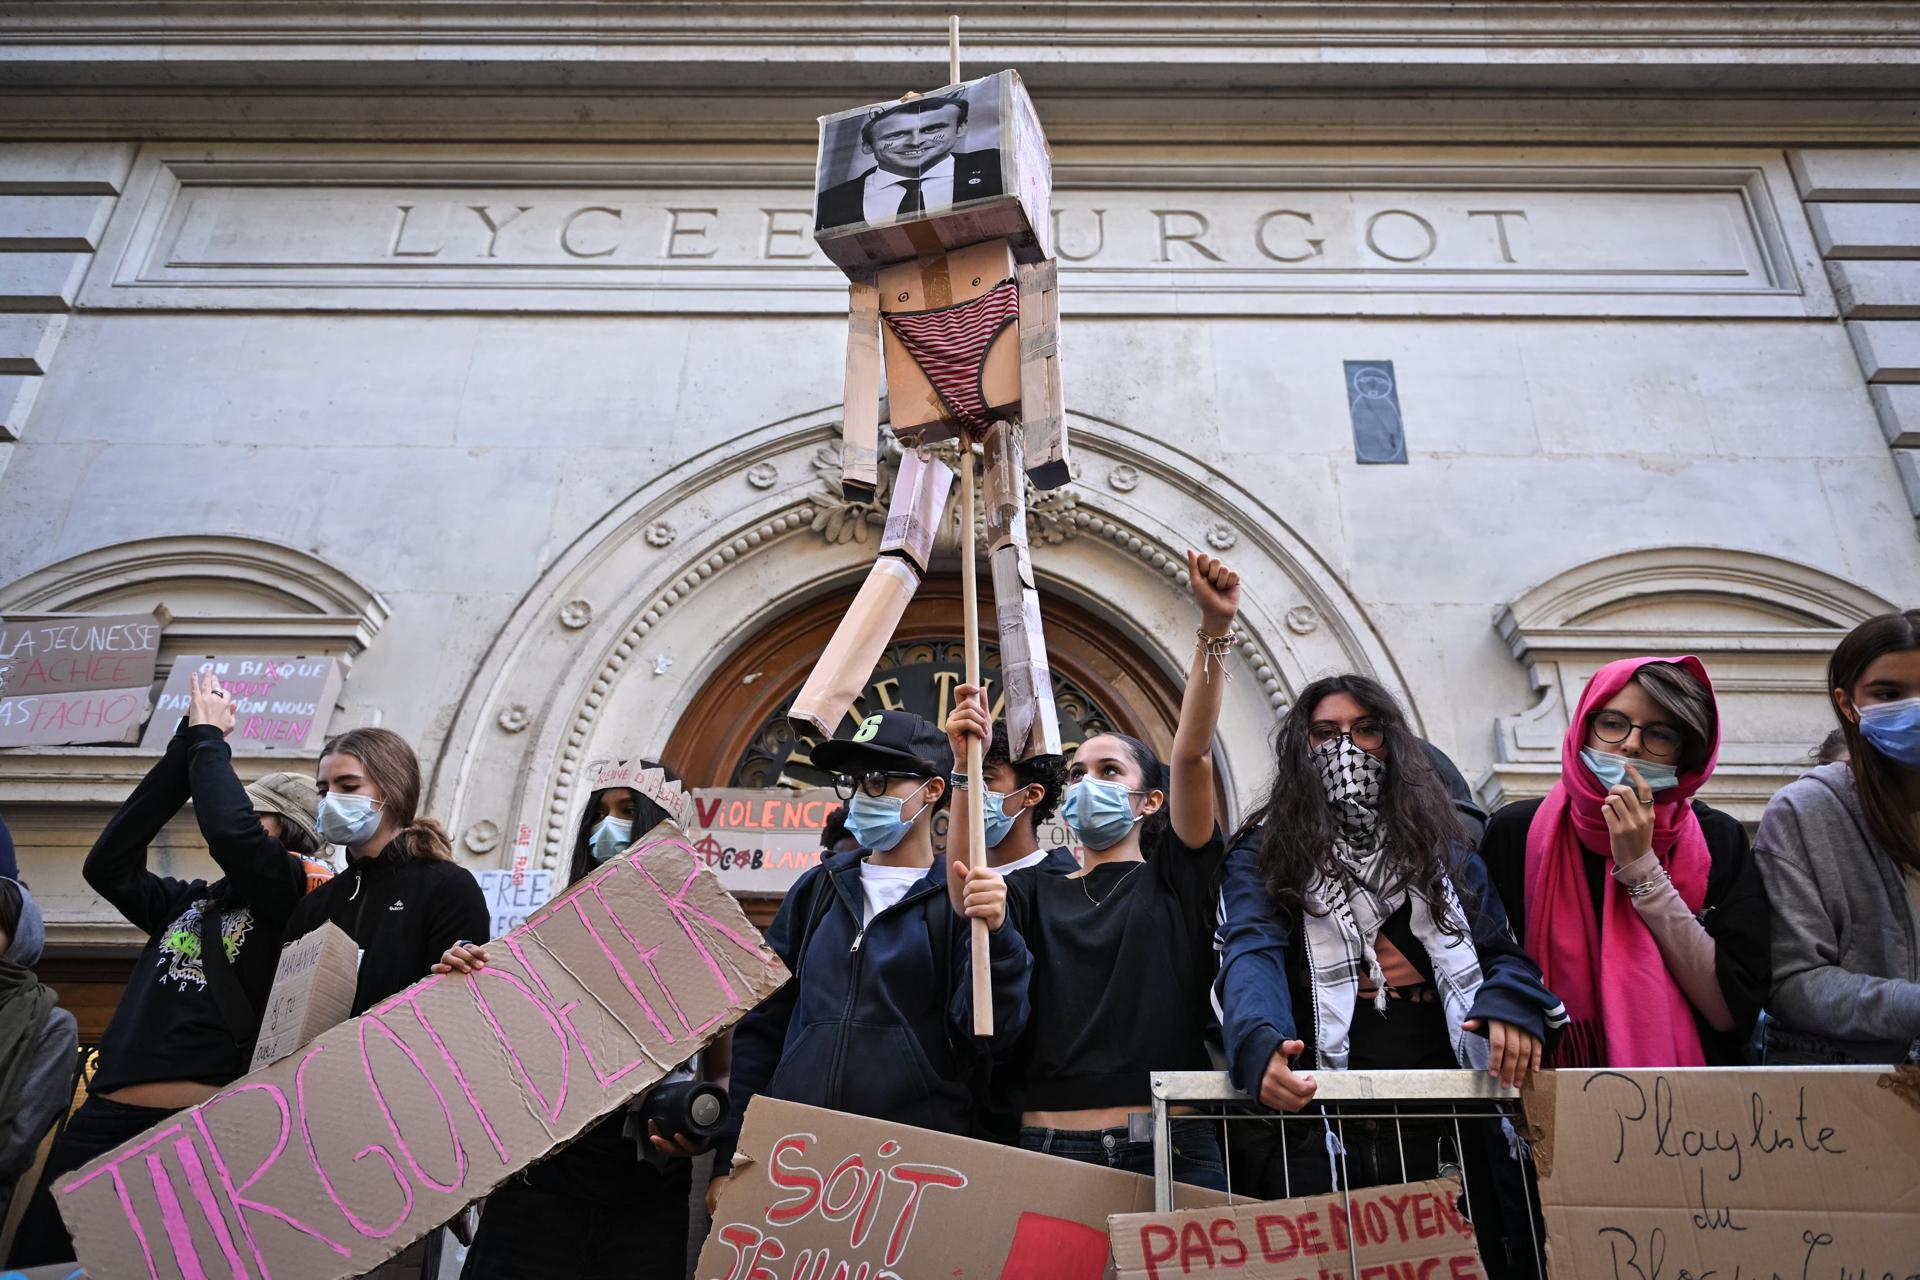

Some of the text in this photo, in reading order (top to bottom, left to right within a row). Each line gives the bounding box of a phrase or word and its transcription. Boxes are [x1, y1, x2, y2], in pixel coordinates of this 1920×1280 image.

[386, 205, 1530, 263] LYCEE URGOT
[0, 623, 159, 659] LA JEUNESSE
[222, 680, 276, 697] TOUT
[0, 697, 39, 726] AS
[28, 694, 137, 732] FACHO
[271, 700, 317, 716] NOUS
[242, 717, 313, 742] RIEN
[1584, 1071, 1846, 1181] Playliste
[1693, 1167, 1748, 1231] du
[1140, 1218, 1249, 1280] PAS
[1256, 1211, 1330, 1263] DE
[1328, 1189, 1473, 1252] MOYEN
